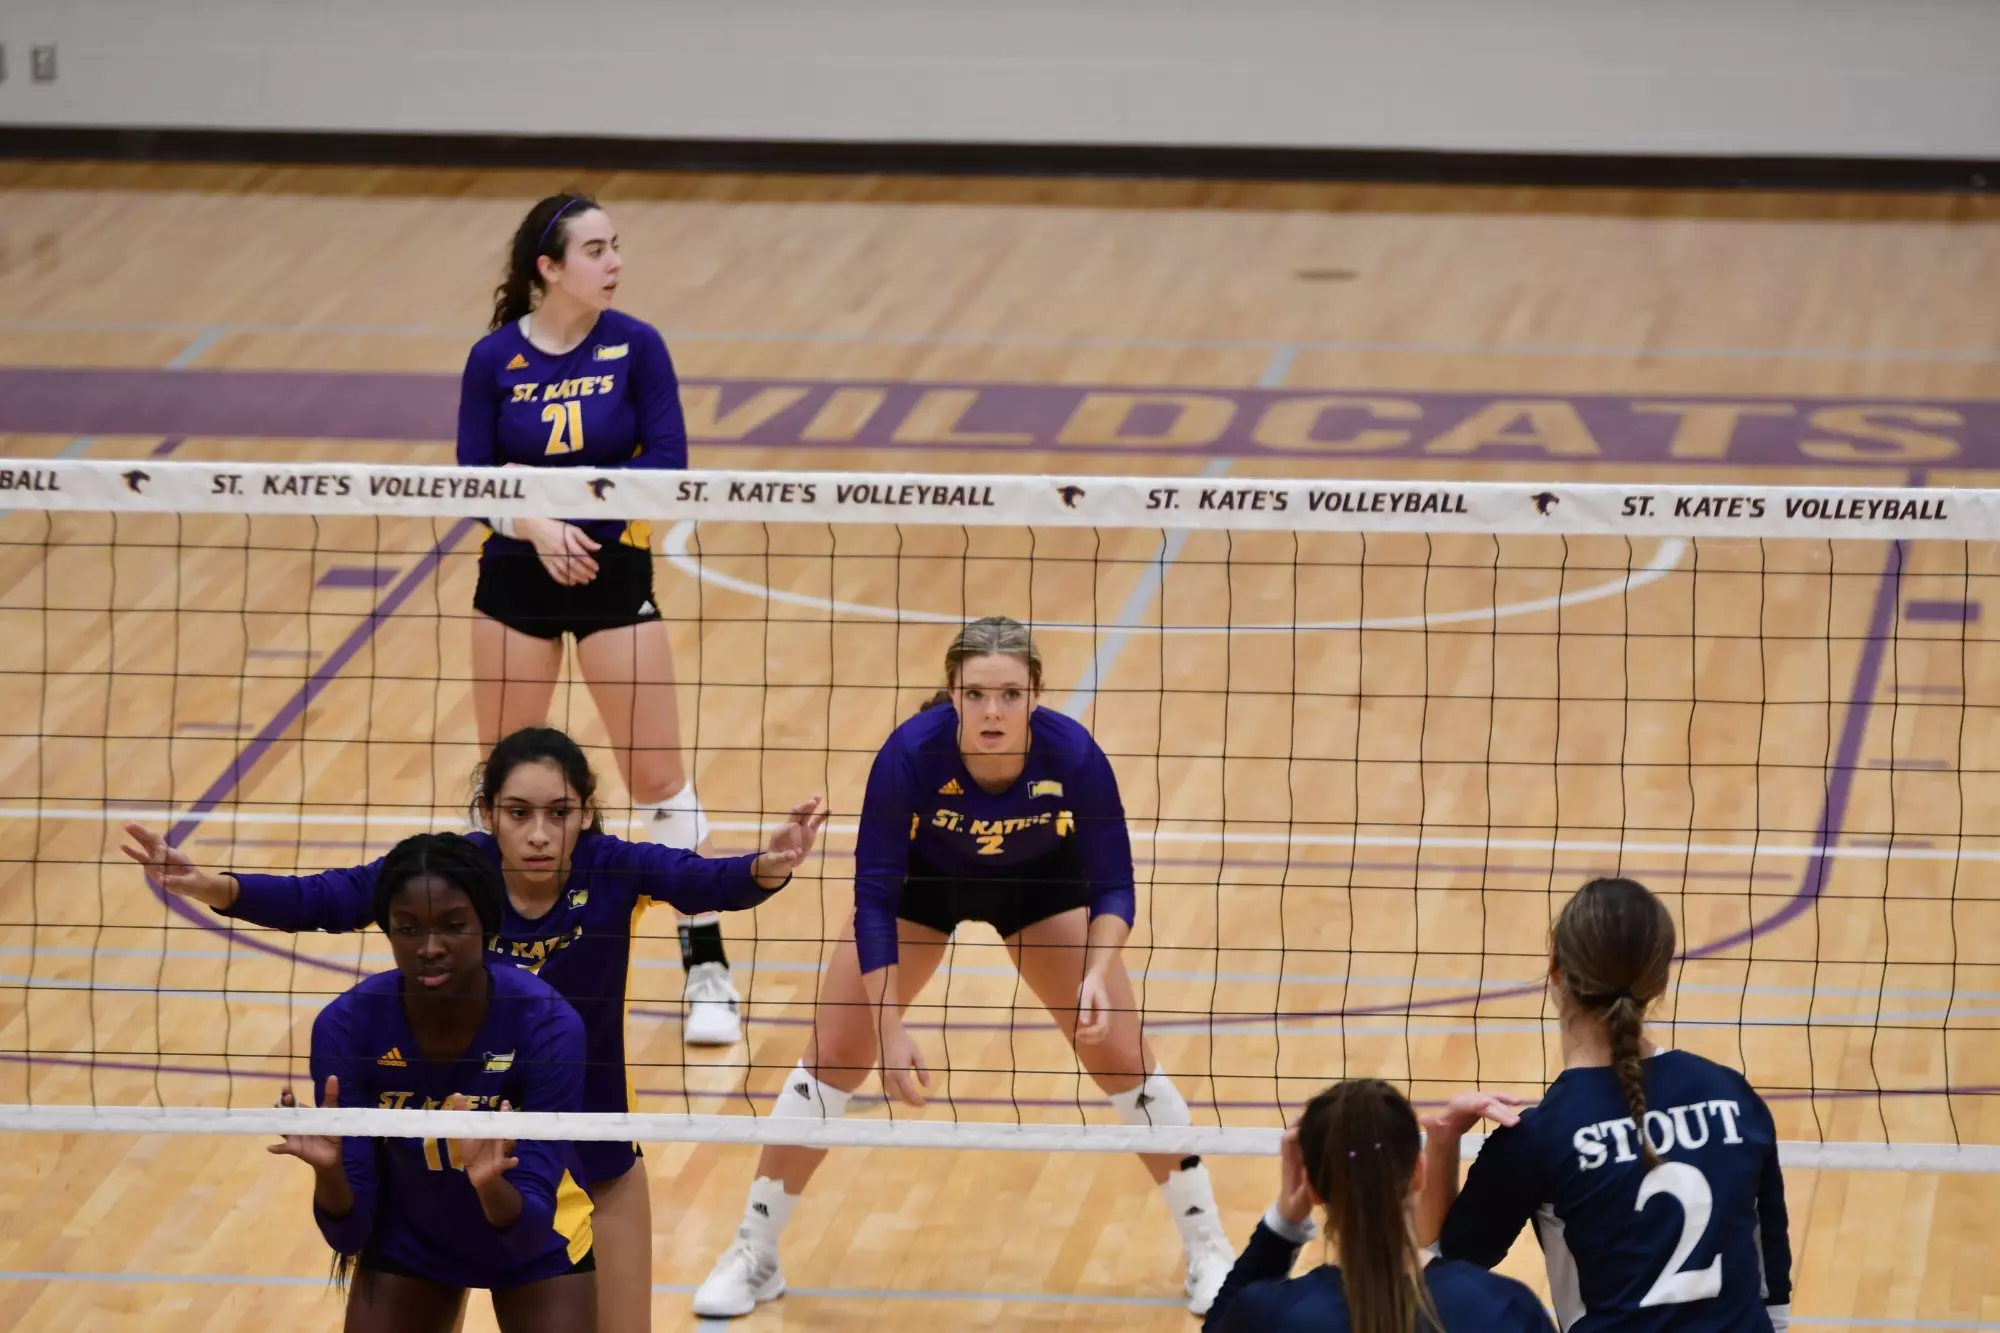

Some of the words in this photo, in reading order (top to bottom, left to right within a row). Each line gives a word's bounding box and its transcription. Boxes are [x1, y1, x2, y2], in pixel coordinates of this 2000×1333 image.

[511, 383, 539, 403] ST.
[542, 374, 615, 402] KATE'S
[541, 400, 584, 456] 21
[0, 470, 60, 491] BALL
[211, 474, 243, 495] ST.
[262, 475, 351, 497] KATE'S
[369, 477, 526, 500] VOLLEYBALL
[675, 481, 709, 502] ST.
[727, 481, 817, 504] KATE'S
[836, 484, 995, 507] VOLLEYBALL
[1145, 488, 1180, 510] ST.
[1198, 489, 1289, 512] KATE'S
[1307, 491, 1469, 515] VOLLEYBALL
[1620, 496, 1656, 518] ST.
[1673, 496, 1766, 519] KATE'S
[1784, 498, 1949, 521] VOLLEYBALL
[931, 808, 964, 833] ST.
[975, 834, 1005, 856] 2
[1573, 1099, 1743, 1171] STOUT
[1634, 1161, 1723, 1308] 2
